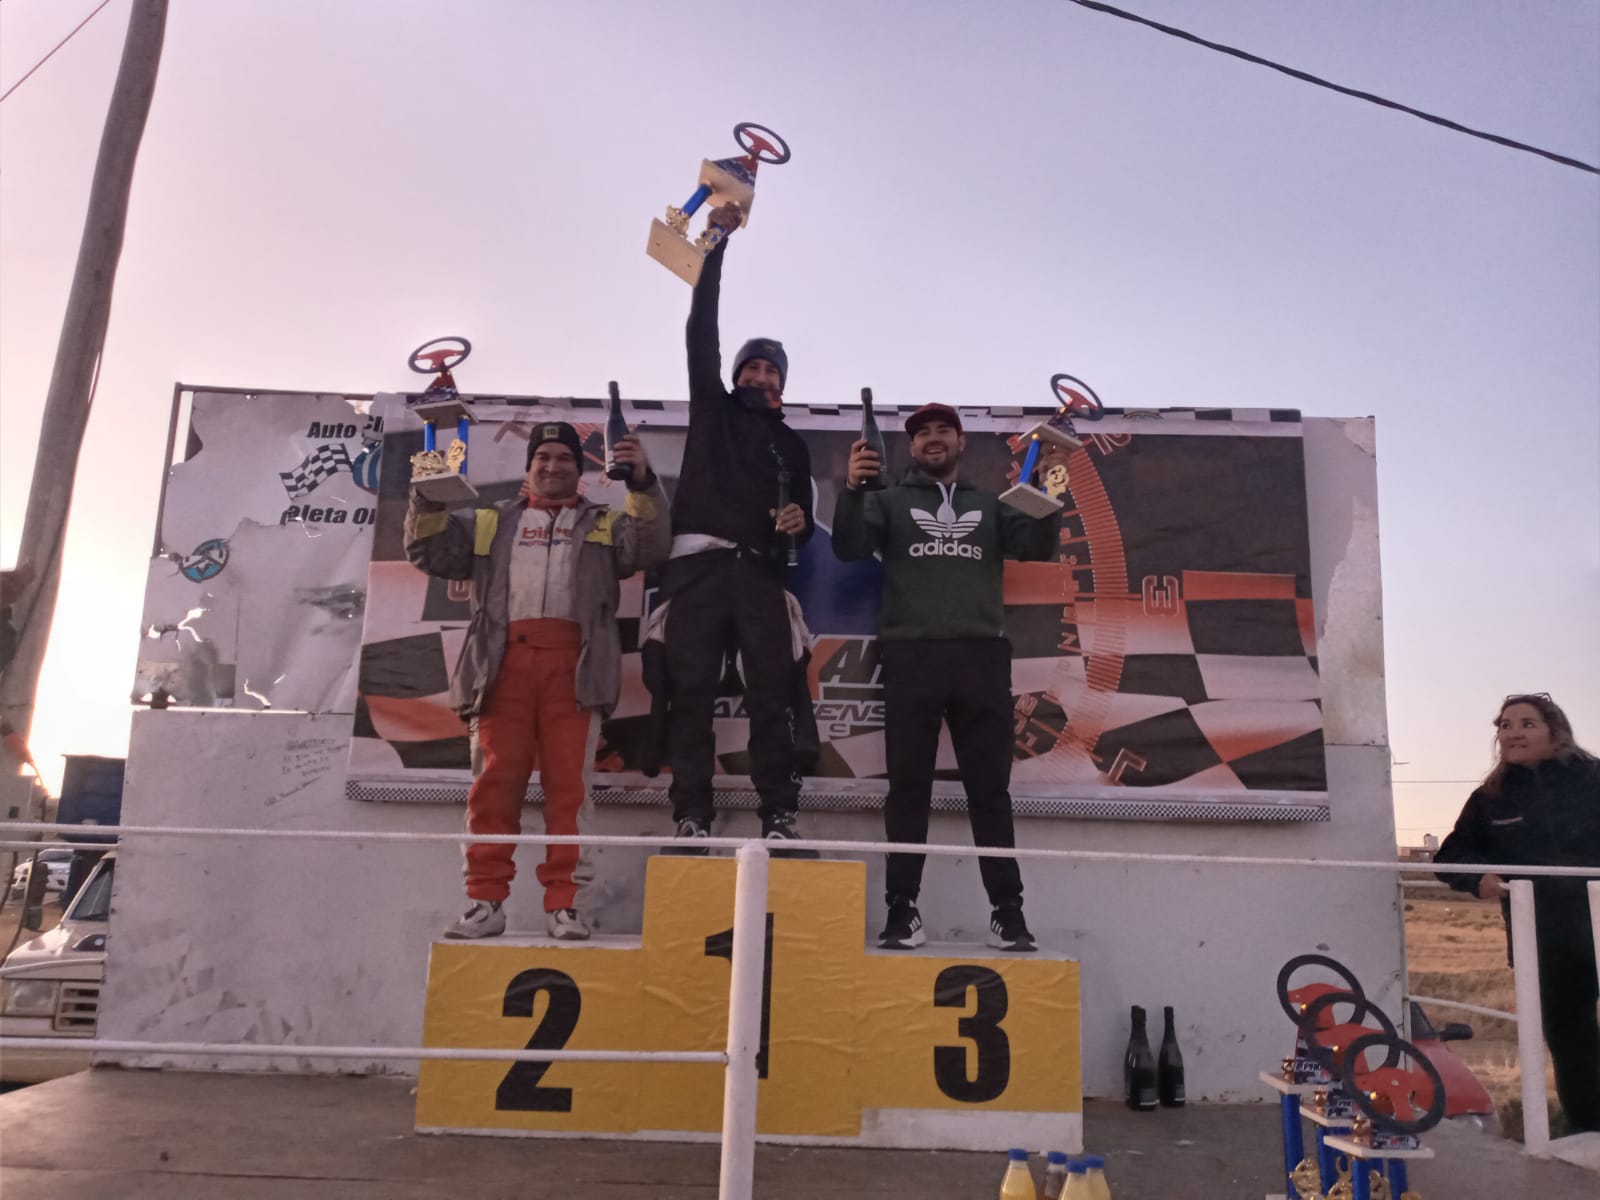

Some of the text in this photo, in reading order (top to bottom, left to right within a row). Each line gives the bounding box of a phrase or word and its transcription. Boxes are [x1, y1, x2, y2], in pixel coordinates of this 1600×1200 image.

[307, 421, 357, 439] Auto
[908, 538, 983, 560] adidas
[495, 967, 582, 1113] 2
[933, 965, 1011, 1104] 3
